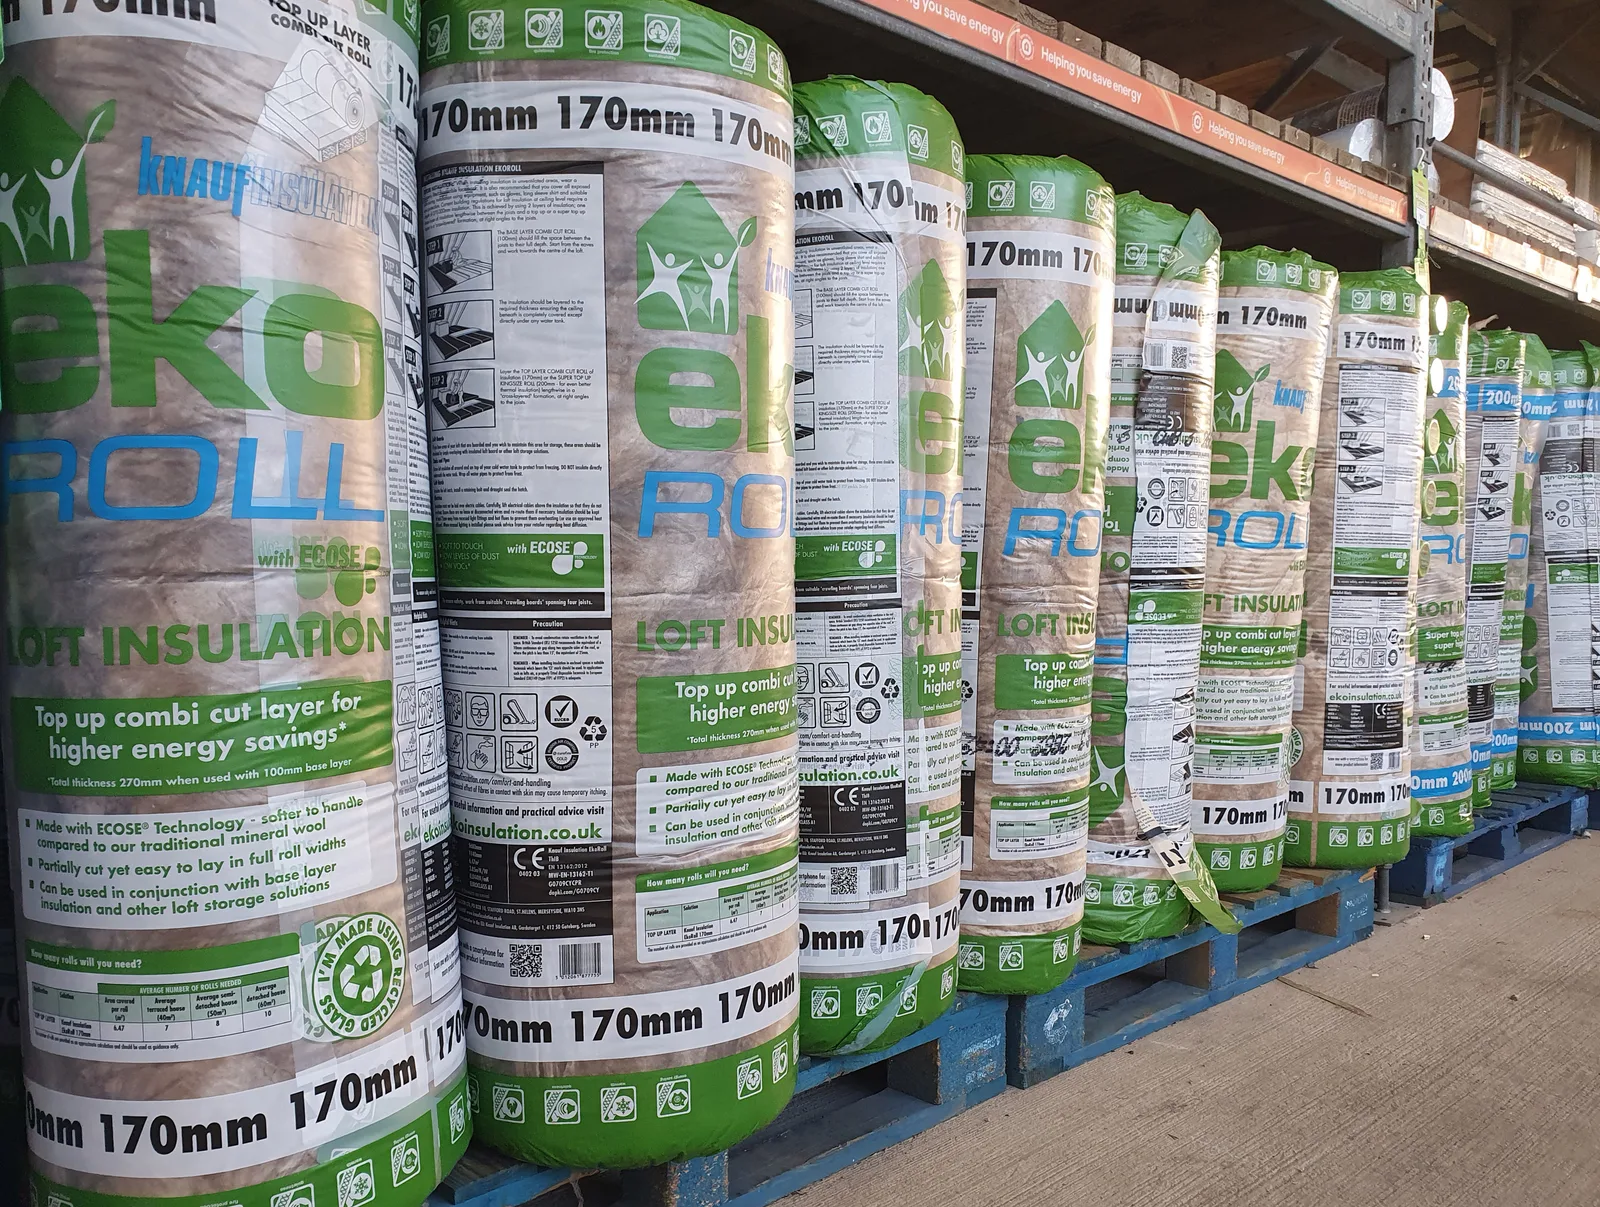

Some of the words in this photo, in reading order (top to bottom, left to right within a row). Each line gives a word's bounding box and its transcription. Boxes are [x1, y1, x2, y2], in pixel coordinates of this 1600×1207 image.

[307, 9, 329, 29] UP
[333, 20, 371, 52] LAYER
[922, 1, 942, 19] you
[944, 7, 967, 27] save
[968, 13, 1005, 45] energy
[347, 47, 372, 69] ROLL
[1041, 45, 1075, 76] Helping
[1076, 62, 1092, 80] you
[1093, 73, 1113, 89] save
[1112, 79, 1143, 104] energy
[557, 95, 695, 139] 170mm
[1208, 119, 1235, 144] Helping
[1235, 132, 1247, 148] you
[1247, 139, 1263, 154] save
[1262, 146, 1285, 166] energy
[494, 164, 522, 173] EKOROLL
[250, 163, 380, 236] INSULATION
[966, 241, 1063, 269] 170mm
[0, 229, 385, 421] eko
[1240, 305, 1308, 330] 170mm
[1343, 331, 1406, 351] 170mm
[4, 434, 385, 523] ROLL
[258, 551, 293, 569] with
[482, 552, 500, 560] DUST
[507, 543, 527, 554] with
[823, 543, 840, 553] with
[1417, 601, 1451, 618] LOFT
[532, 619, 564, 629] Precaution
[637, 619, 726, 652] LOFT
[997, 613, 1060, 637] LOFT
[1216, 631, 1232, 641] up
[1235, 629, 1267, 640] combi
[1269, 629, 1282, 640] cut
[1425, 630, 1449, 641] Super
[9, 627, 86, 668] LOFT
[102, 615, 391, 667] INSULATION
[1241, 645, 1276, 656] energy
[1434, 642, 1454, 651] super
[938, 661, 951, 676] up
[1023, 658, 1048, 674] Top
[1052, 659, 1066, 674] up
[674, 681, 709, 702] Top
[715, 682, 737, 700] up
[741, 672, 780, 694] combi
[923, 679, 955, 697] higher
[1033, 676, 1072, 692] higher
[1329, 690, 1402, 702] ekoinsulation.co.uk
[35, 705, 68, 734] Top
[75, 711, 106, 735] up
[114, 702, 199, 728] combi
[210, 702, 252, 724] cut
[260, 697, 325, 724] layer
[331, 691, 362, 713] for
[690, 703, 746, 726] higher
[750, 697, 790, 716] energy
[49, 735, 123, 766] higher
[131, 738, 235, 763] energy
[72, 777, 116, 788] thickness
[119, 777, 163, 788] 270mm
[166, 775, 199, 786] when
[203, 771, 231, 785] used
[234, 769, 260, 782] with
[263, 765, 303, 778] 100mm
[305, 762, 328, 773] base
[329, 758, 352, 771] layer
[665, 771, 698, 784] Made
[700, 767, 723, 780] with
[1013, 768, 1052, 777] insulation
[665, 798, 711, 815] Partially
[713, 798, 729, 808] cut
[1324, 786, 1386, 806] 170mm
[36, 818, 63, 833] Made
[65, 822, 93, 835] with
[154, 817, 246, 835] Technology
[261, 808, 302, 825] softer
[306, 805, 319, 817] to
[322, 796, 364, 814] handle
[467, 803, 503, 817] information
[505, 805, 520, 817] and
[521, 806, 556, 819] practical
[558, 805, 584, 816] advice
[586, 804, 605, 816] visit
[1202, 806, 1267, 825] 170mm
[37, 837, 89, 854] compared
[93, 842, 106, 852] to
[110, 842, 136, 853] our
[140, 833, 225, 852] traditional
[231, 824, 289, 845] mineral
[292, 817, 327, 836] wool
[38, 857, 81, 878] Partially
[84, 864, 103, 876] cut
[107, 864, 130, 879] yet
[134, 865, 172, 878] easy
[176, 862, 193, 874] to
[198, 858, 225, 874] lay
[229, 856, 244, 869] in
[249, 849, 273, 866] full
[278, 844, 301, 861] roll
[305, 837, 347, 856] widths
[39, 880, 57, 894] Can
[60, 883, 74, 896] be
[78, 885, 107, 899] used
[111, 887, 125, 899] in
[129, 882, 219, 902] conjunction
[224, 875, 260, 893] with
[265, 870, 300, 886] base
[303, 862, 337, 881] layer
[40, 896, 92, 915] insulation
[96, 902, 123, 916] and
[126, 903, 167, 916] other
[171, 899, 199, 914] loft
[204, 893, 265, 912] storage
[269, 879, 331, 902] solutions
[334, 917, 374, 950] MADE
[376, 919, 402, 961] USING
[317, 952, 338, 983] I'M
[139, 986, 165, 994] AVERAGE
[165, 985, 190, 993] NUMBER
[190, 984, 200, 992] OF
[200, 981, 219, 991] ROLLS
[219, 978, 242, 989] NEEDED
[360, 966, 403, 1032] RECYCLED
[718, 970, 796, 1025] 170mm
[319, 994, 356, 1033] GLASS
[571, 1006, 703, 1043] 170mm
[100, 1113, 268, 1156] 170mm
[290, 1054, 417, 1131] 170mm
